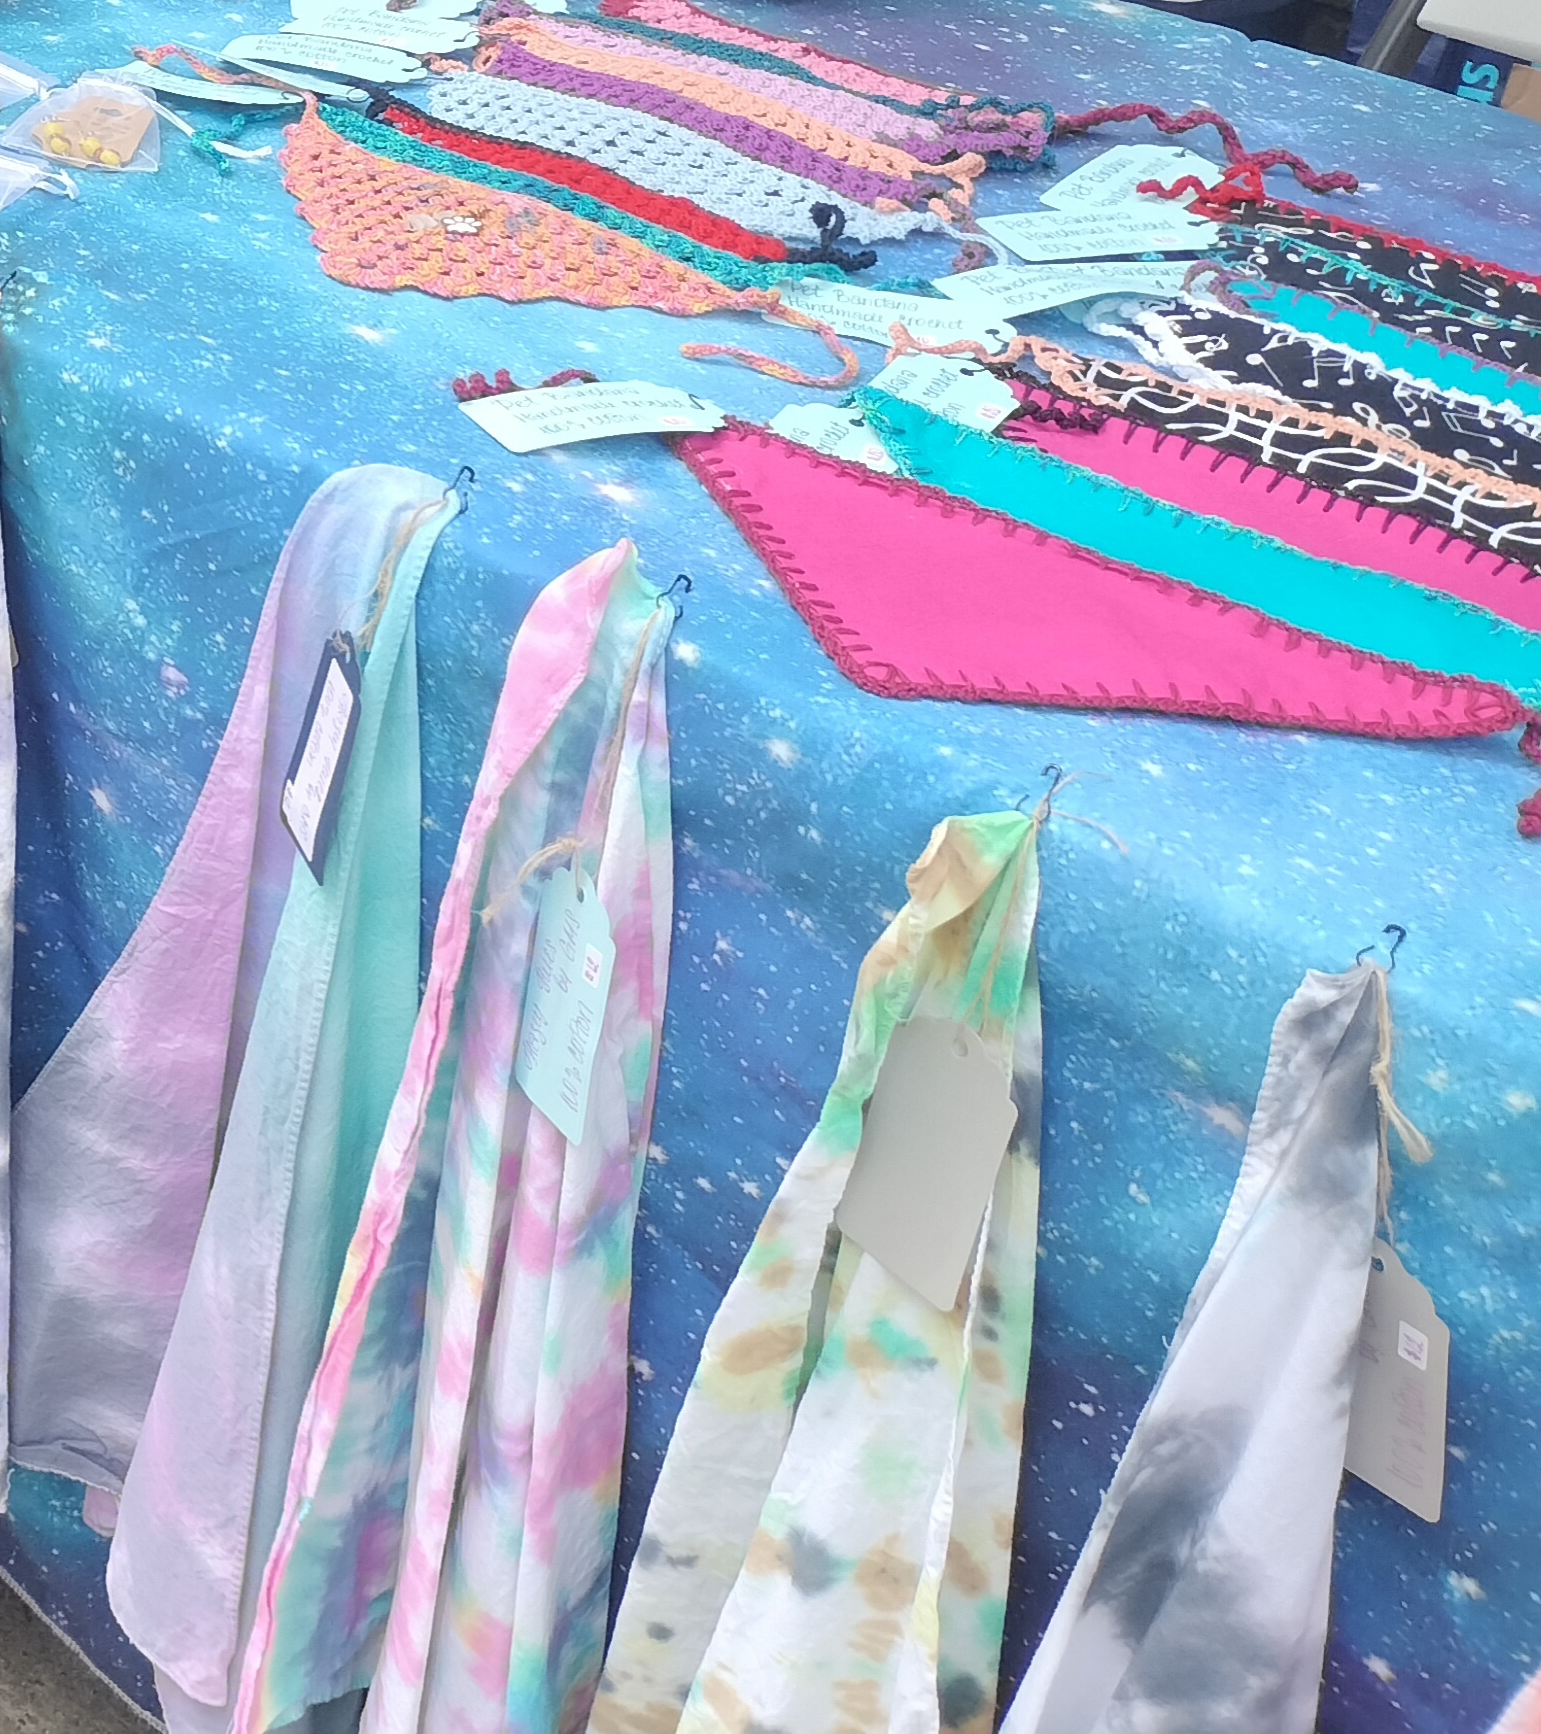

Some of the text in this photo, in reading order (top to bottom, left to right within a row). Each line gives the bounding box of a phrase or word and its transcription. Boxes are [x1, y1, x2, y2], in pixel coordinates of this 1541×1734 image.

[298, 49, 348, 65] cotton
[995, 215, 1041, 232] Pet
[960, 269, 1004, 288] Pet
[789, 281, 920, 313] Pet Bandana
[788, 294, 884, 324] Handmade
[491, 392, 536, 412] Pet
[559, 1066, 584, 1114] 100%
